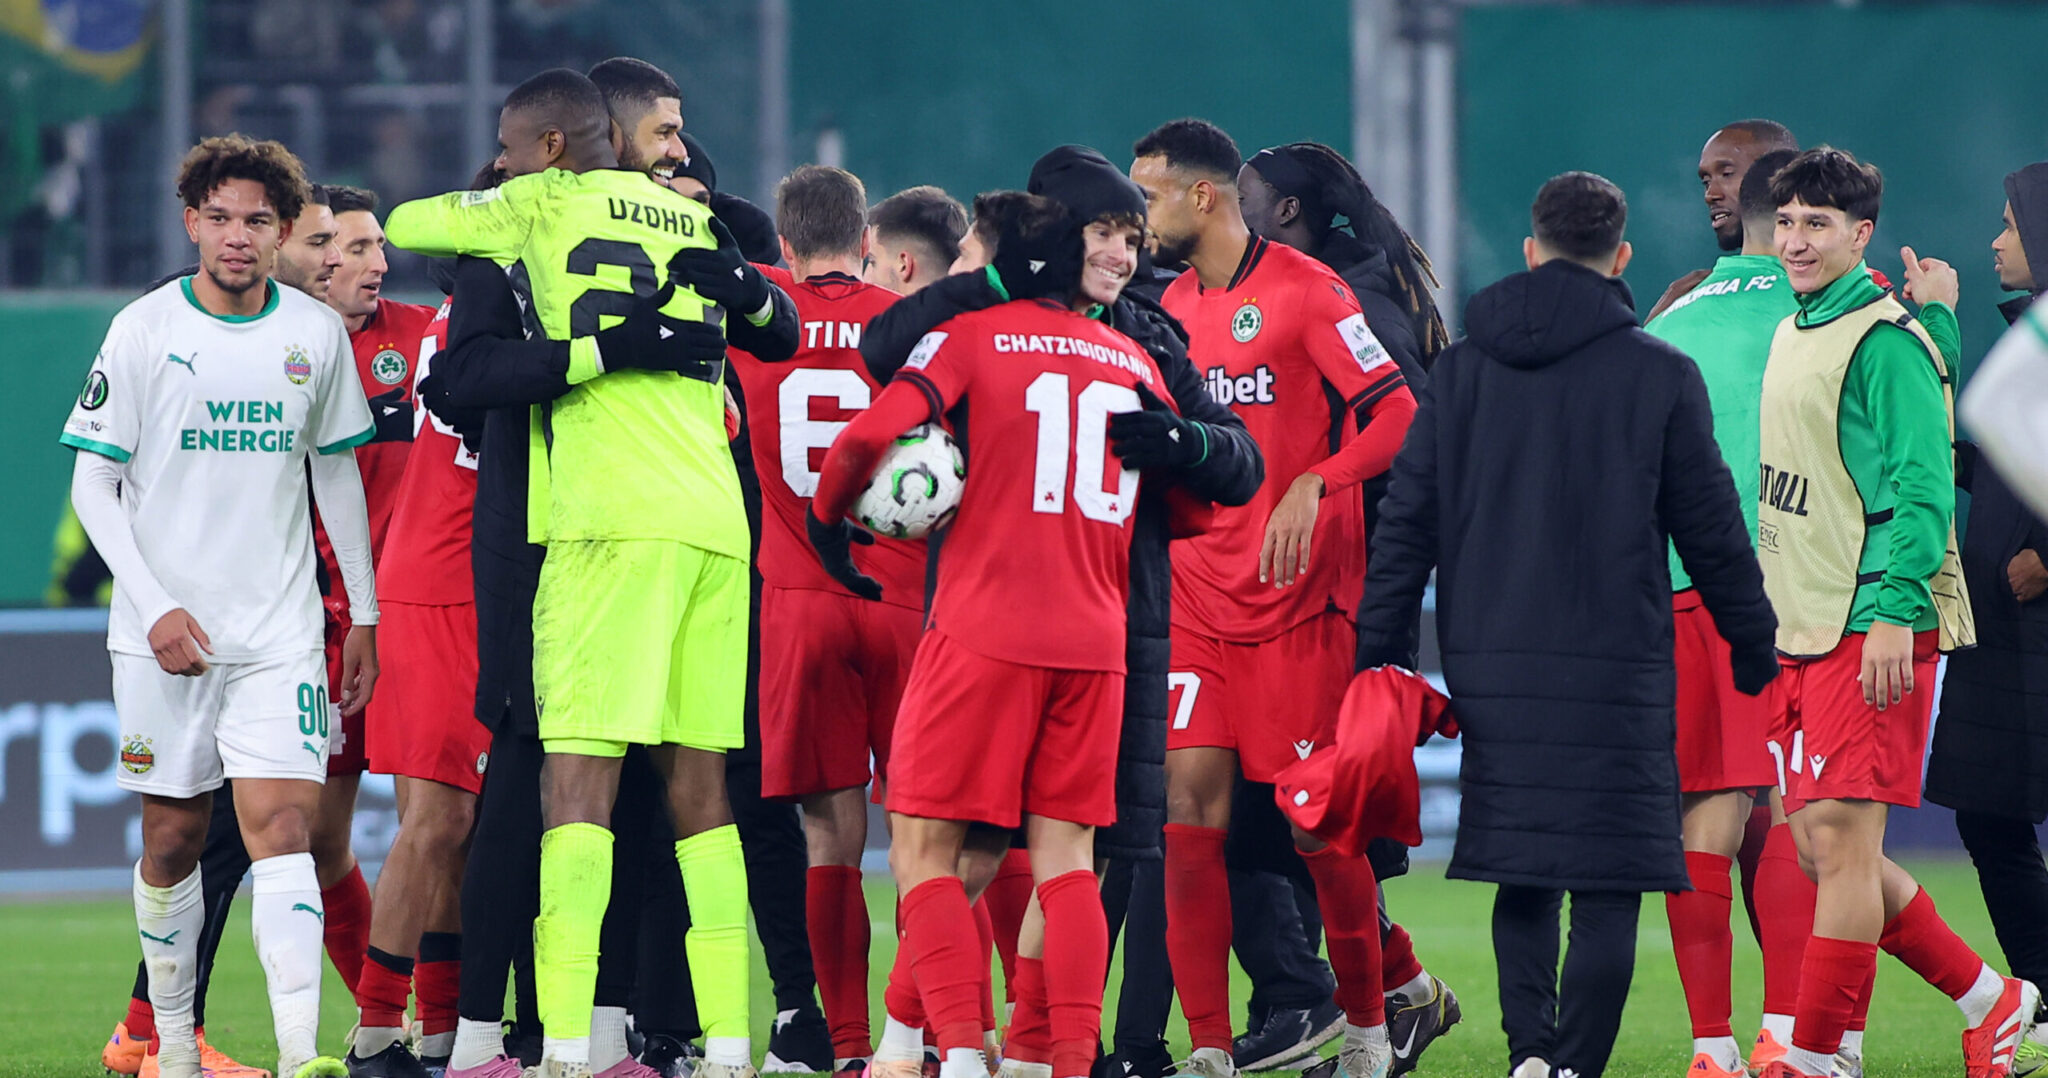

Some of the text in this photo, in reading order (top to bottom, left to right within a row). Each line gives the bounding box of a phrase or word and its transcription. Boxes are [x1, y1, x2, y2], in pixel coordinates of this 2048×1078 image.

[607, 197, 695, 238] UZOHO
[1744, 275, 1778, 292] FC
[994, 333, 1154, 386] CHATZIGIOVANIS
[206, 401, 283, 423] WIEN
[181, 429, 294, 452] ENERGIE
[1025, 371, 1143, 527] 10
[297, 682, 328, 738] 90
[1167, 672, 1201, 730] 7
